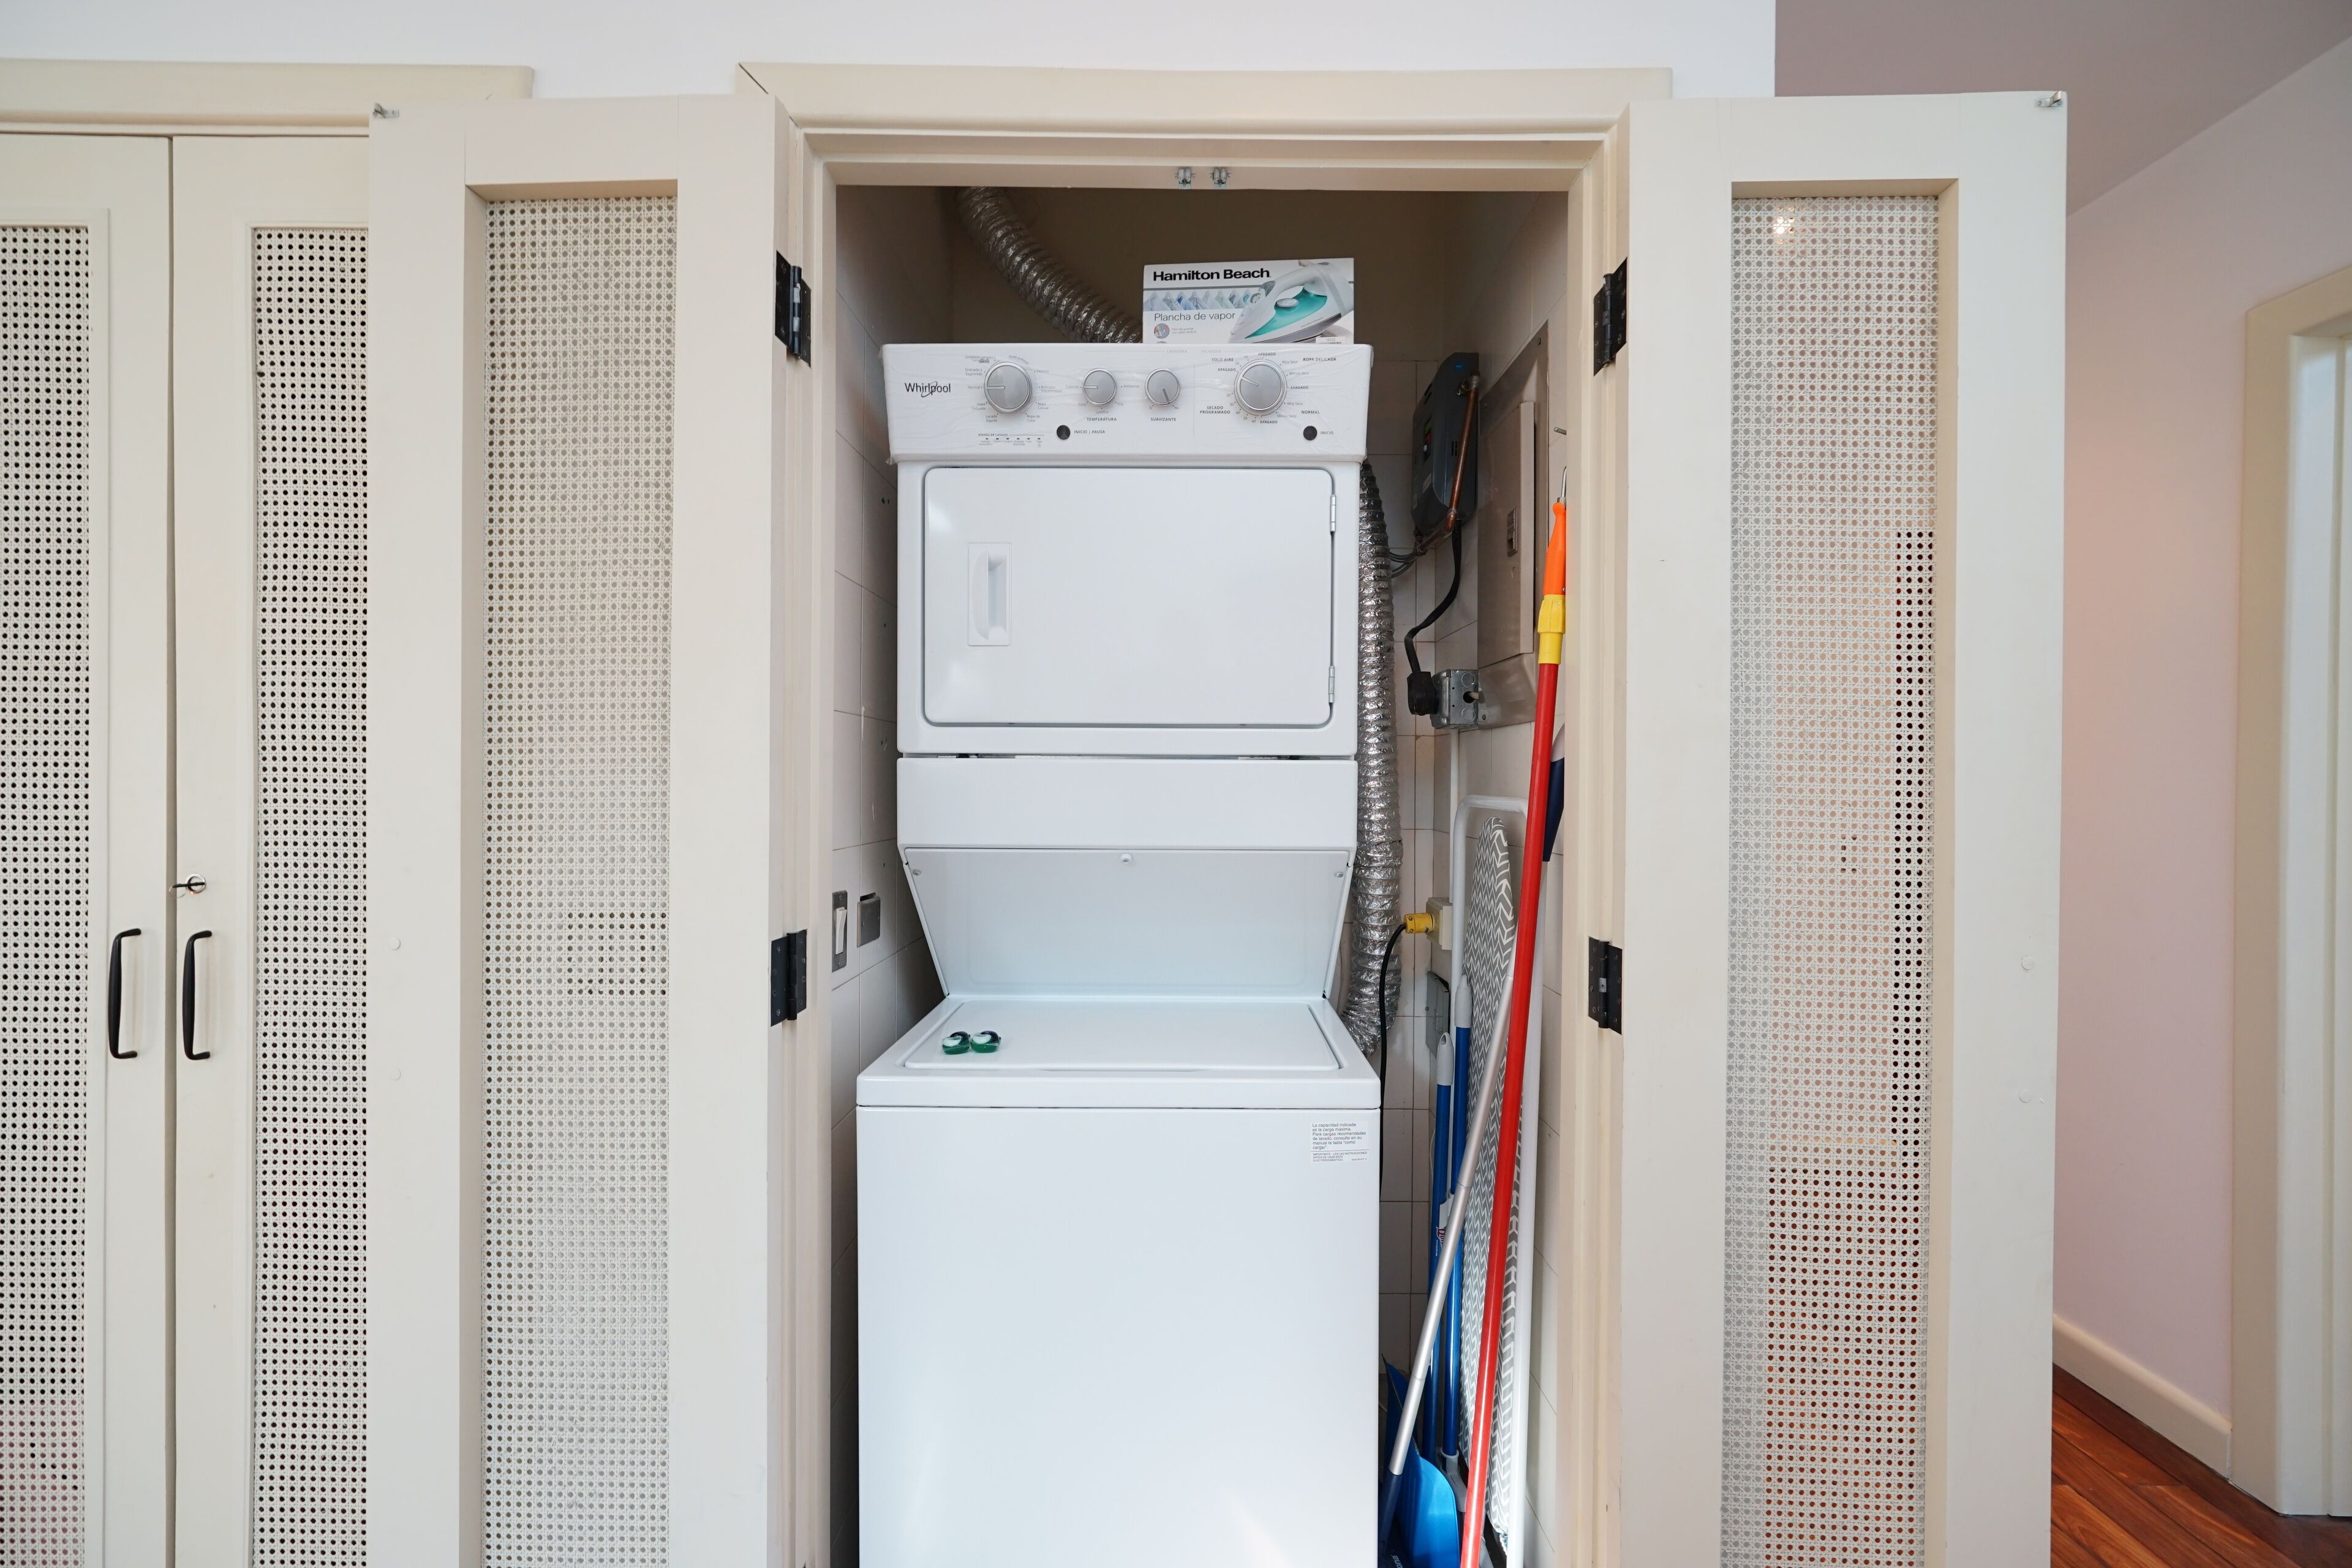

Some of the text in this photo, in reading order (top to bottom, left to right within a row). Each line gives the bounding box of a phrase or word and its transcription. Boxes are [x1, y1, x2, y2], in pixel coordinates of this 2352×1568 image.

[1153, 268, 1270, 281] Hamilton Beach
[1155, 313, 1191, 322] Plancha
[905, 381, 951, 398] Whirlpool
